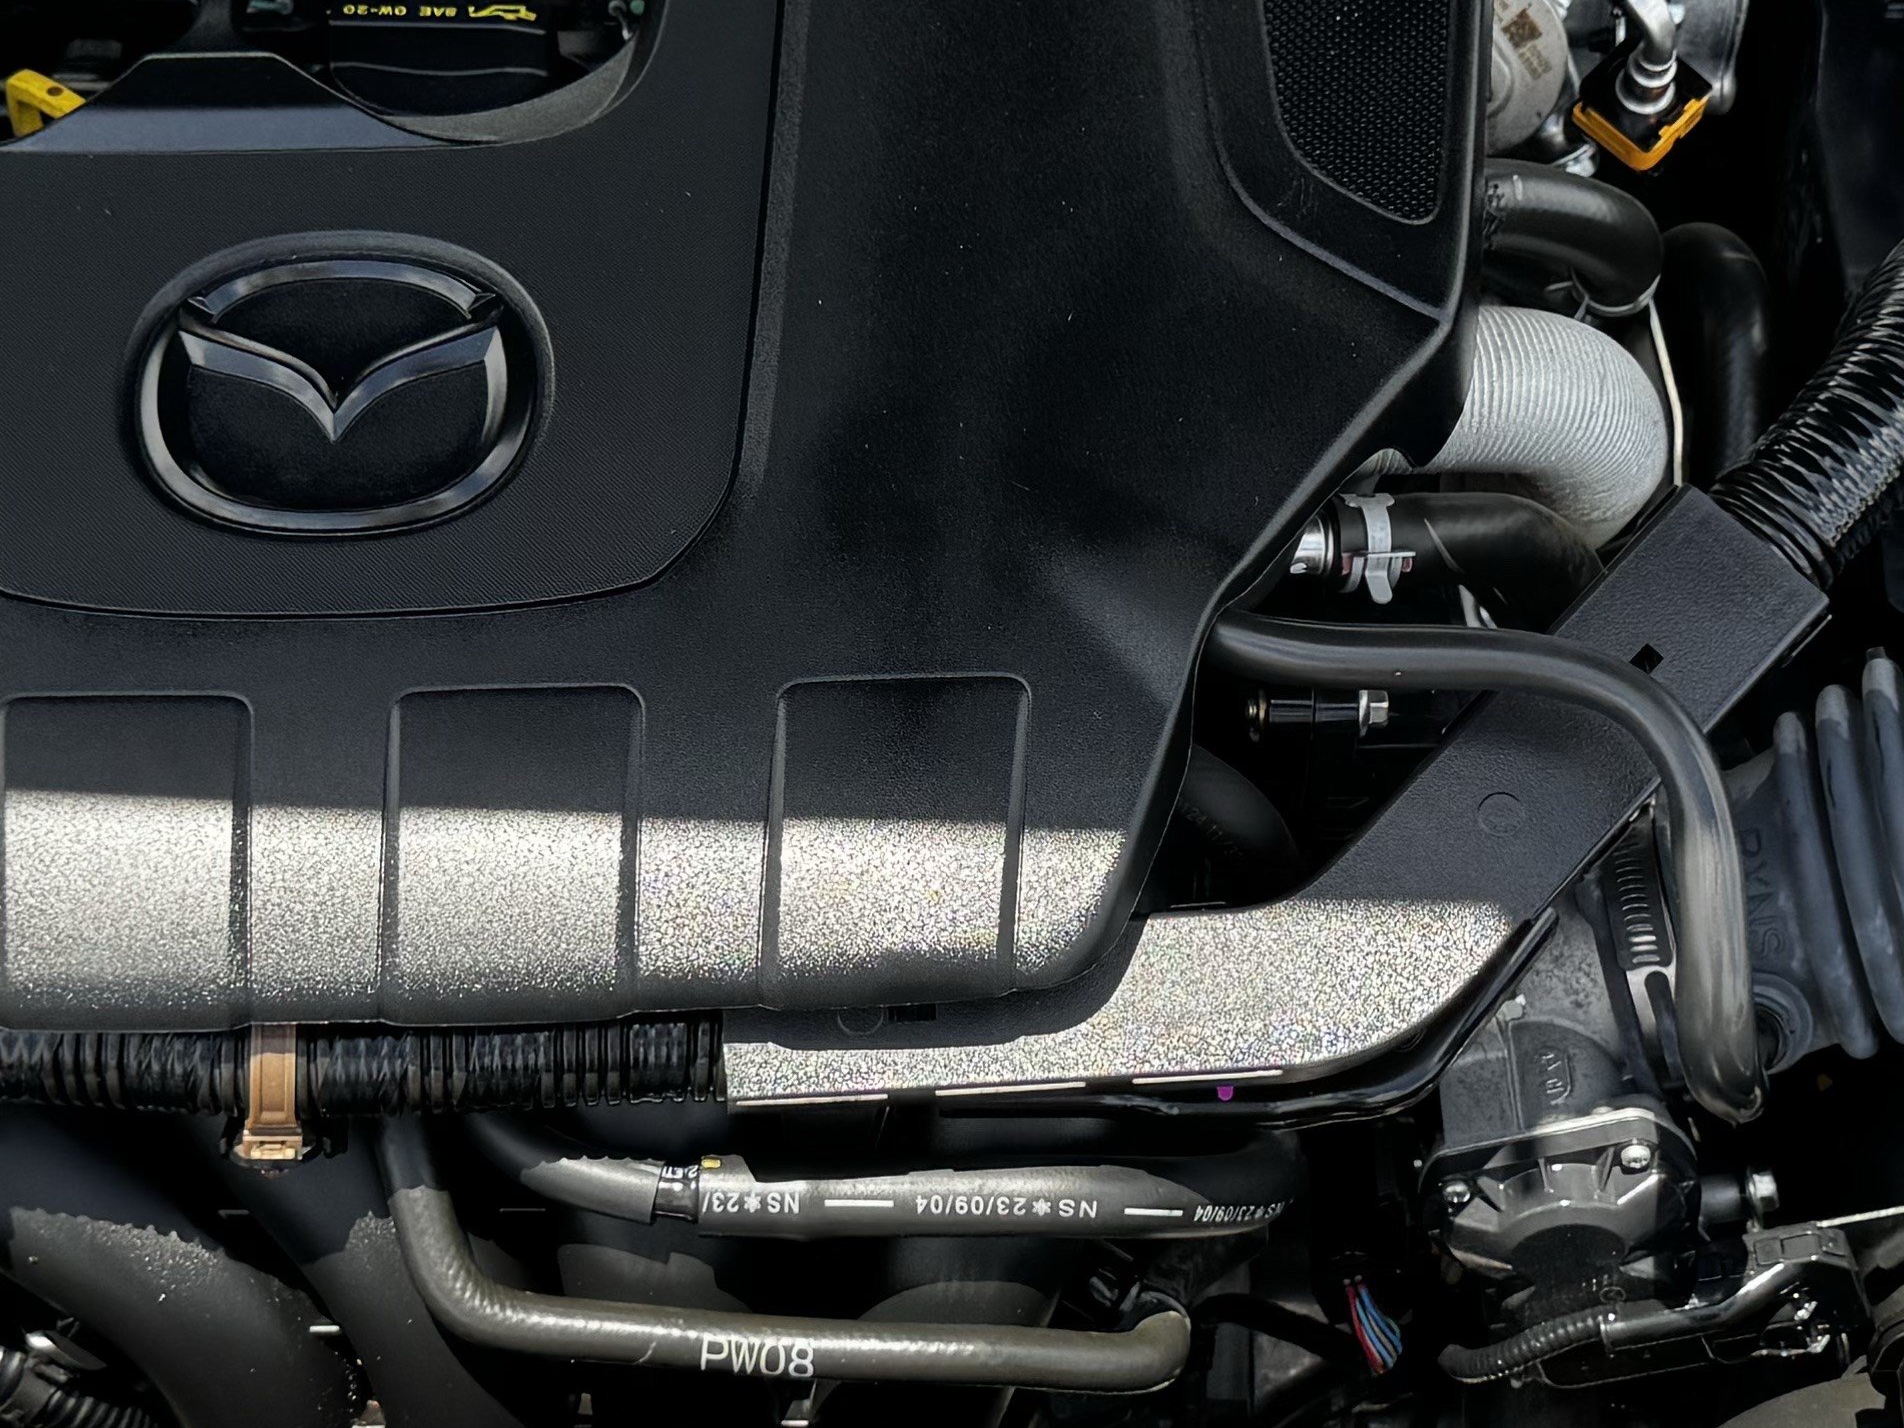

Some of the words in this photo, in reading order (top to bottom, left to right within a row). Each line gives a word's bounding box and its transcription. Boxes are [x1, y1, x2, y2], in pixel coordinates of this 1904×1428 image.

[343, 4, 407, 16] 0W-20
[419, 6, 457, 17] SAE
[700, 1331, 814, 1377] PW08
